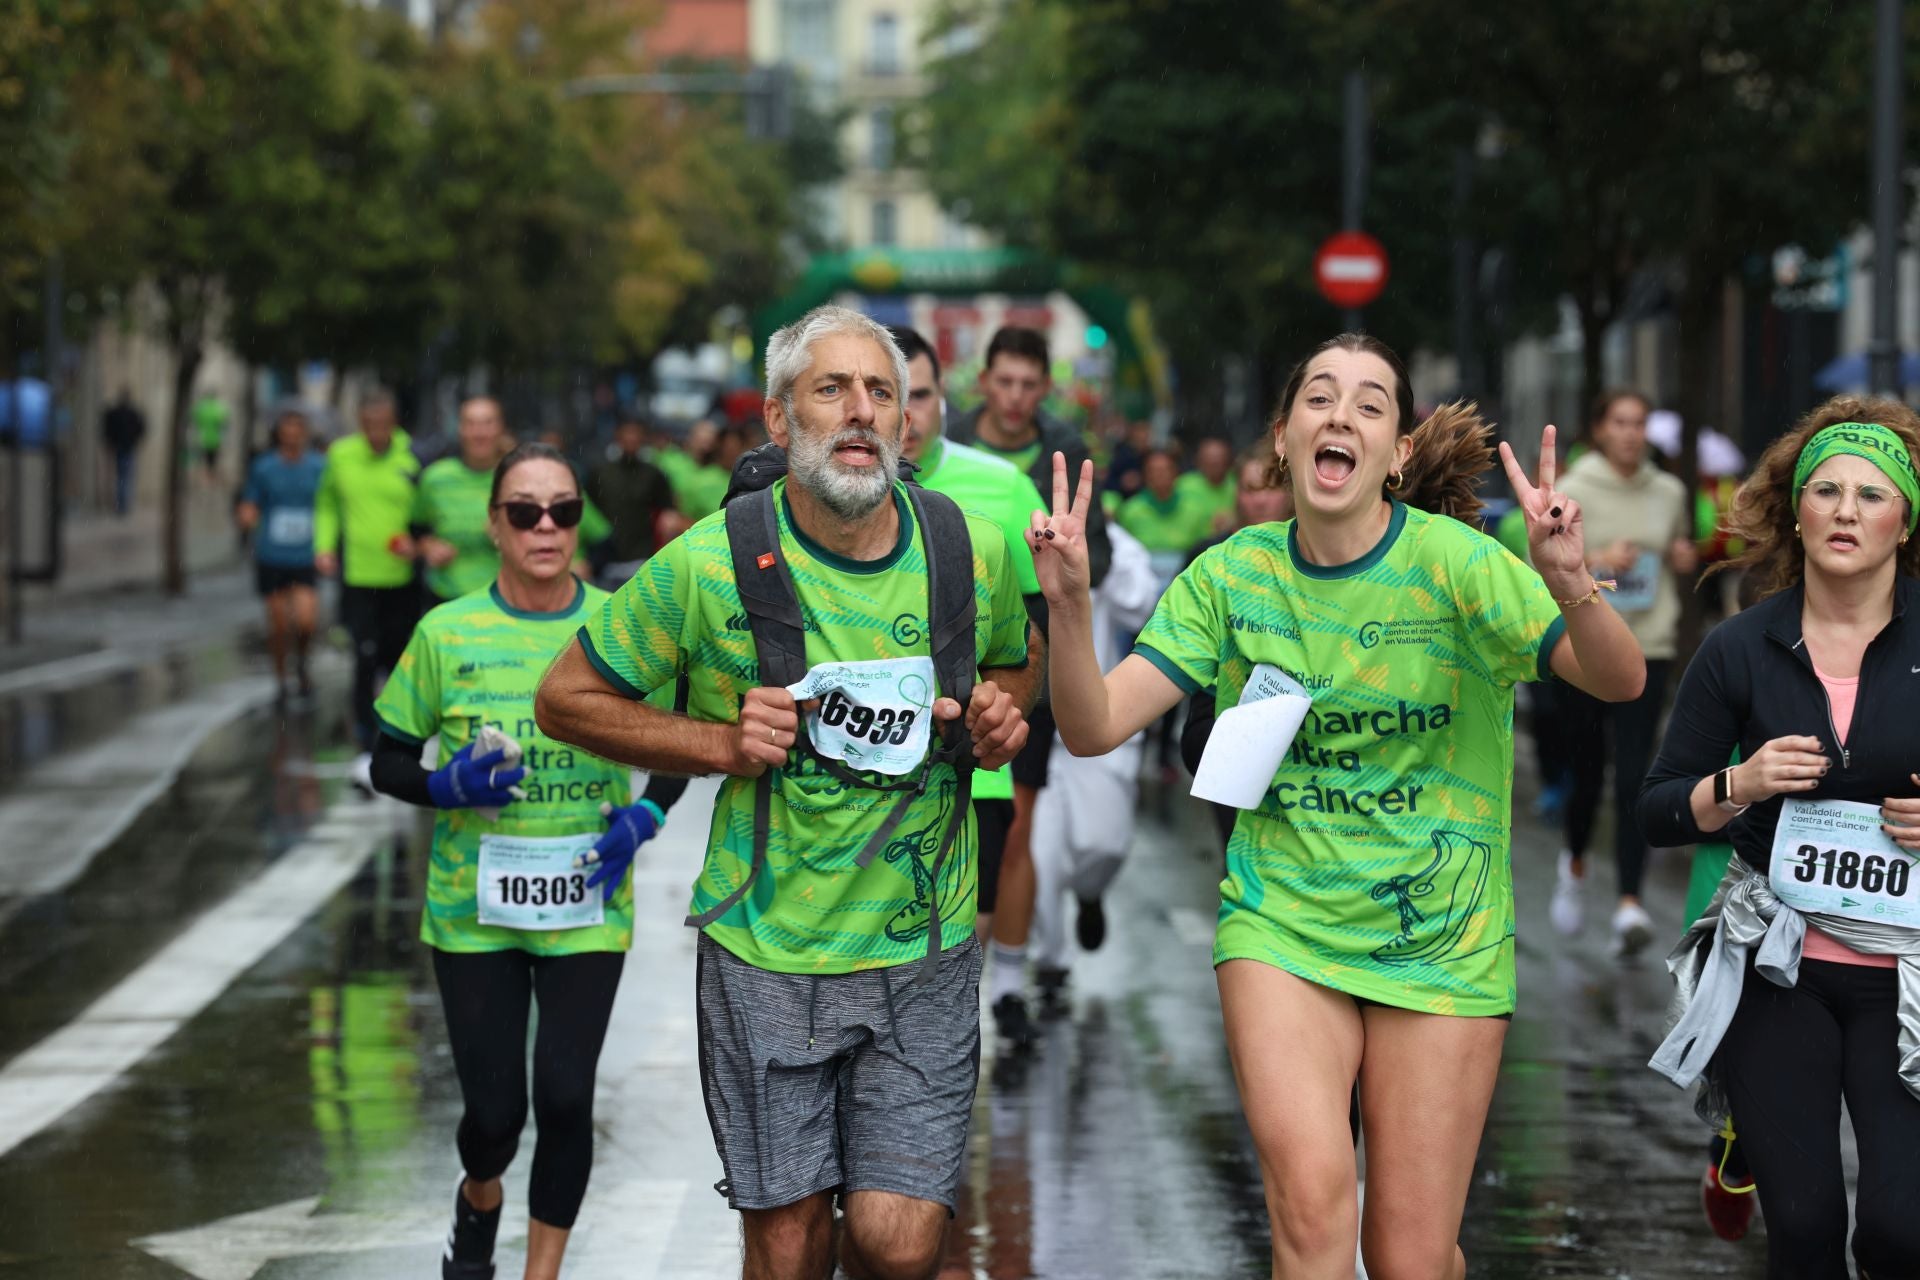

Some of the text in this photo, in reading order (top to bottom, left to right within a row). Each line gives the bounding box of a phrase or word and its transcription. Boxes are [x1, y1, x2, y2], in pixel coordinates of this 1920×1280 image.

[1247, 619, 1302, 641] Iberdrola
[819, 691, 916, 746] 6933
[1274, 775, 1424, 817] cáncer
[1794, 806, 1842, 818] Valladolid
[1791, 814, 1822, 825] contra
[1824, 819, 1834, 827] el
[1794, 844, 1910, 897] 31860
[498, 873, 585, 905] 10303
